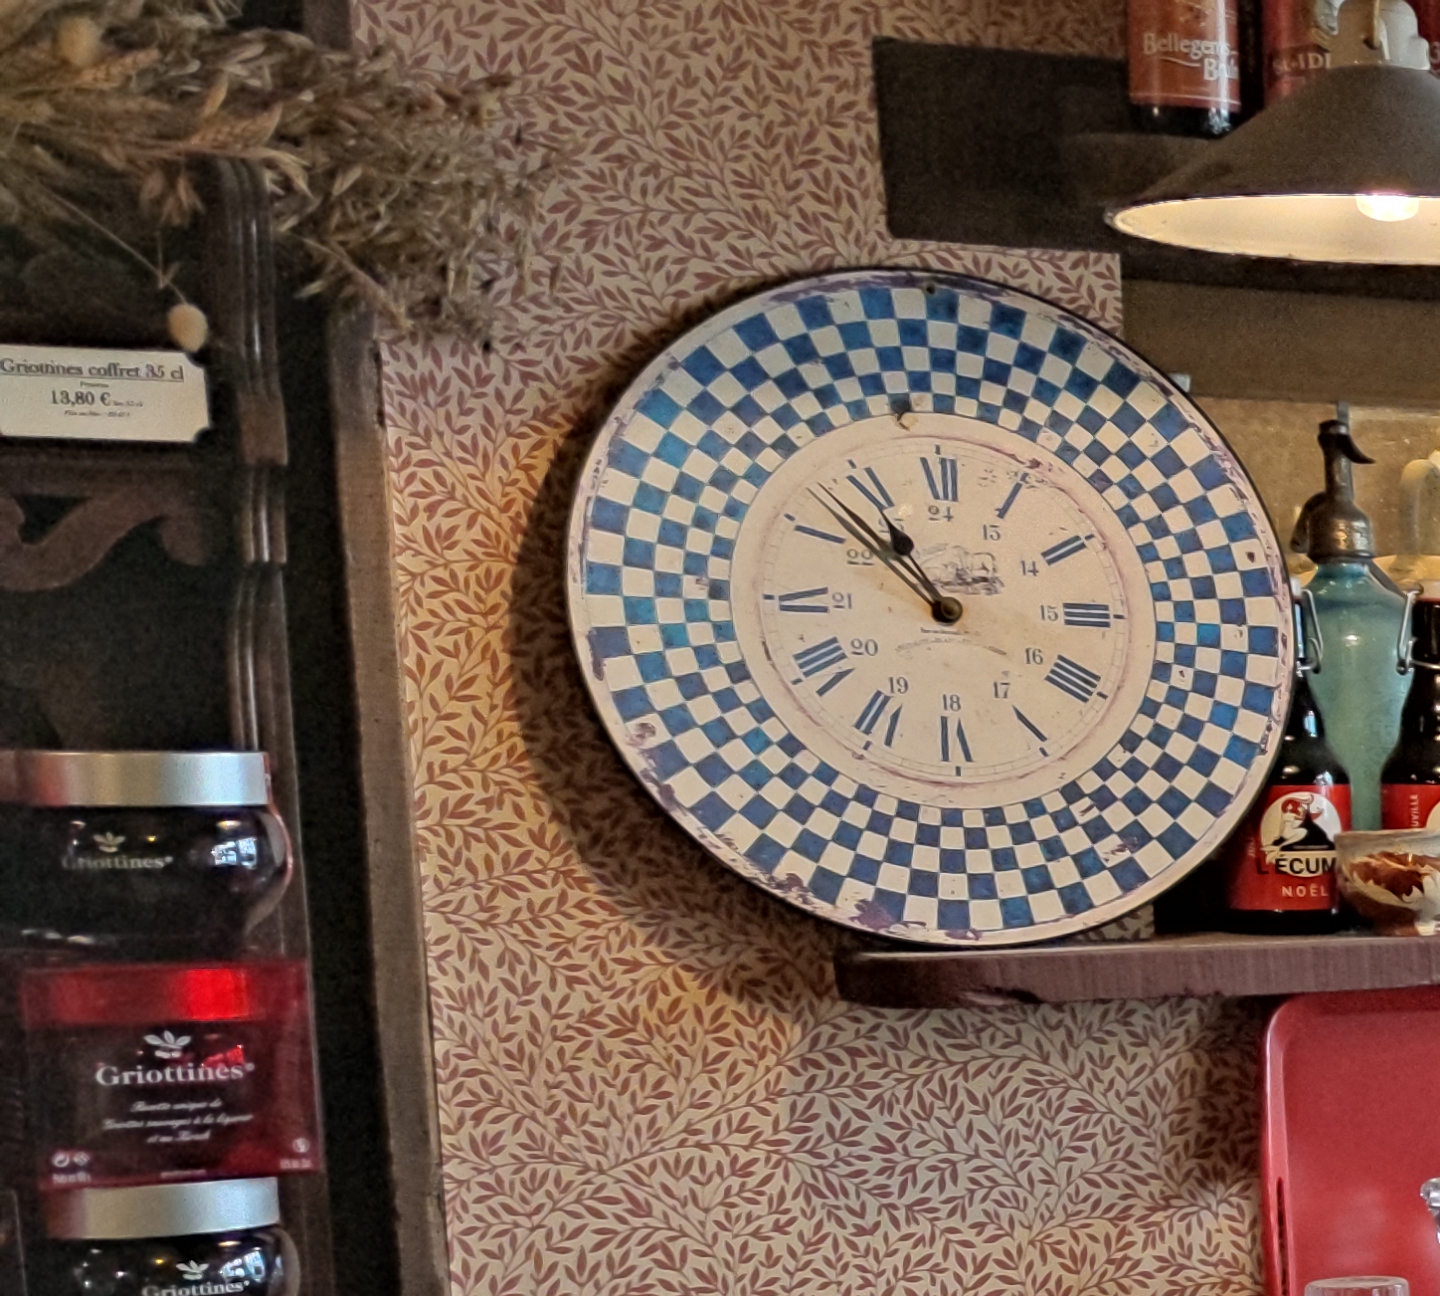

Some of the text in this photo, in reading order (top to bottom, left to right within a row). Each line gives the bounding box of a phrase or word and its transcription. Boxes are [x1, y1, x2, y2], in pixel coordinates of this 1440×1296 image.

[88, 362, 140, 378] coffret
[170, 365, 185, 380] cl
[51, 389, 112, 408] 13,80 €
[1040, 604, 1059, 621] 15
[1025, 648, 1043, 665] 16
[888, 677, 909, 695] 19
[993, 682, 1011, 699] 17
[942, 695, 961, 712] 18
[1281, 884, 1329, 899] NOËL
